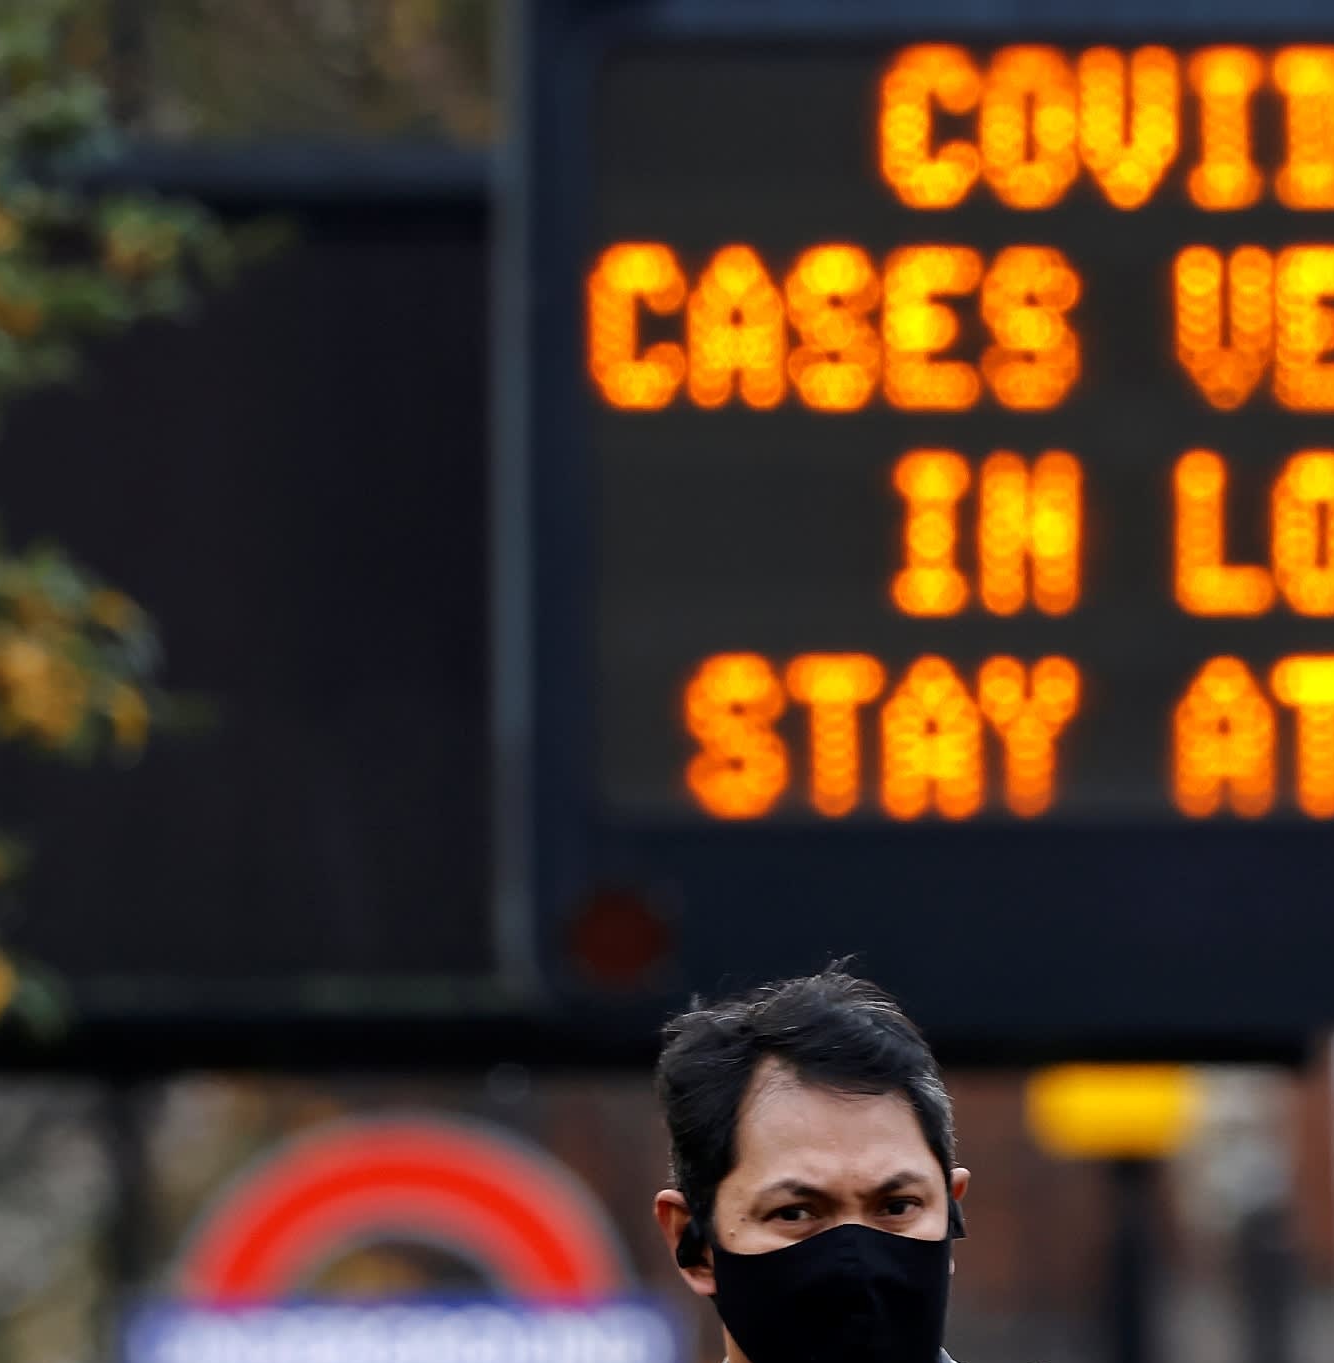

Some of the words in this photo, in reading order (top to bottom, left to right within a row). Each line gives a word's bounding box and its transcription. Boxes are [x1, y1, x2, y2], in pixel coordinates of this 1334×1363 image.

[588, 243, 1080, 411] CASES
[892, 449, 1082, 616] IN
[685, 653, 1080, 818] STAY
